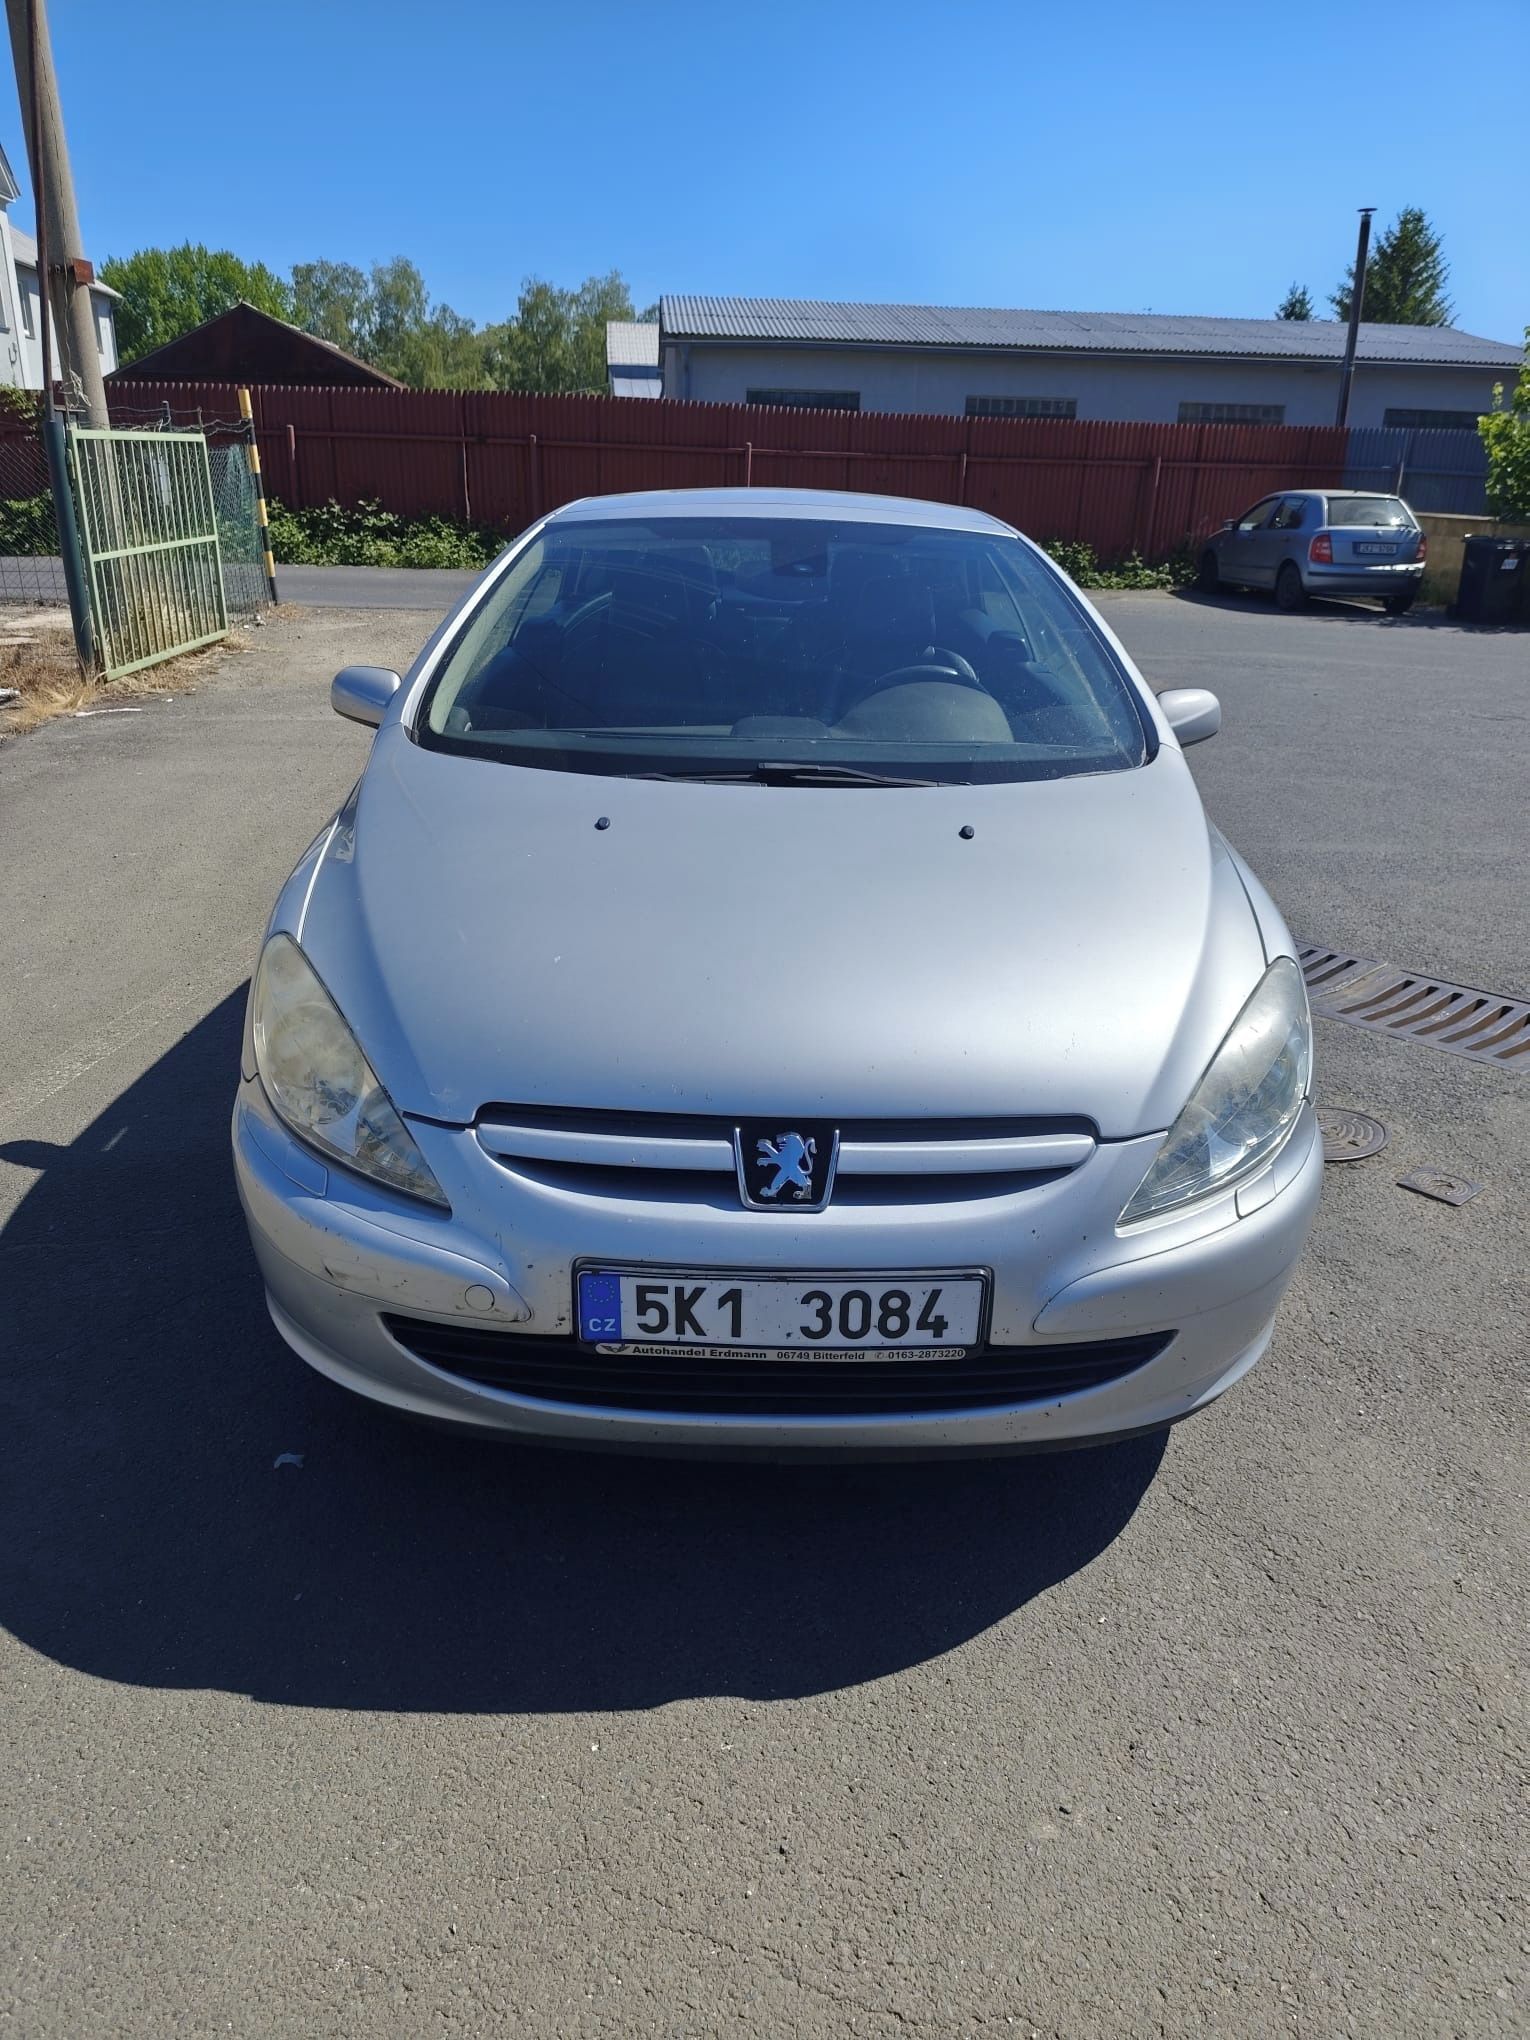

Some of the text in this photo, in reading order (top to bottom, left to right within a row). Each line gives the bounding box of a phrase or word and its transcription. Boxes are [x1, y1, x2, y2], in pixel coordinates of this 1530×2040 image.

[636, 1284, 949, 1340] 5K1 3084
[588, 1318, 617, 1332] CZ
[632, 1345, 964, 1361] Autohandel Erdmann 06749 Bitterfeld 0163-2873220
